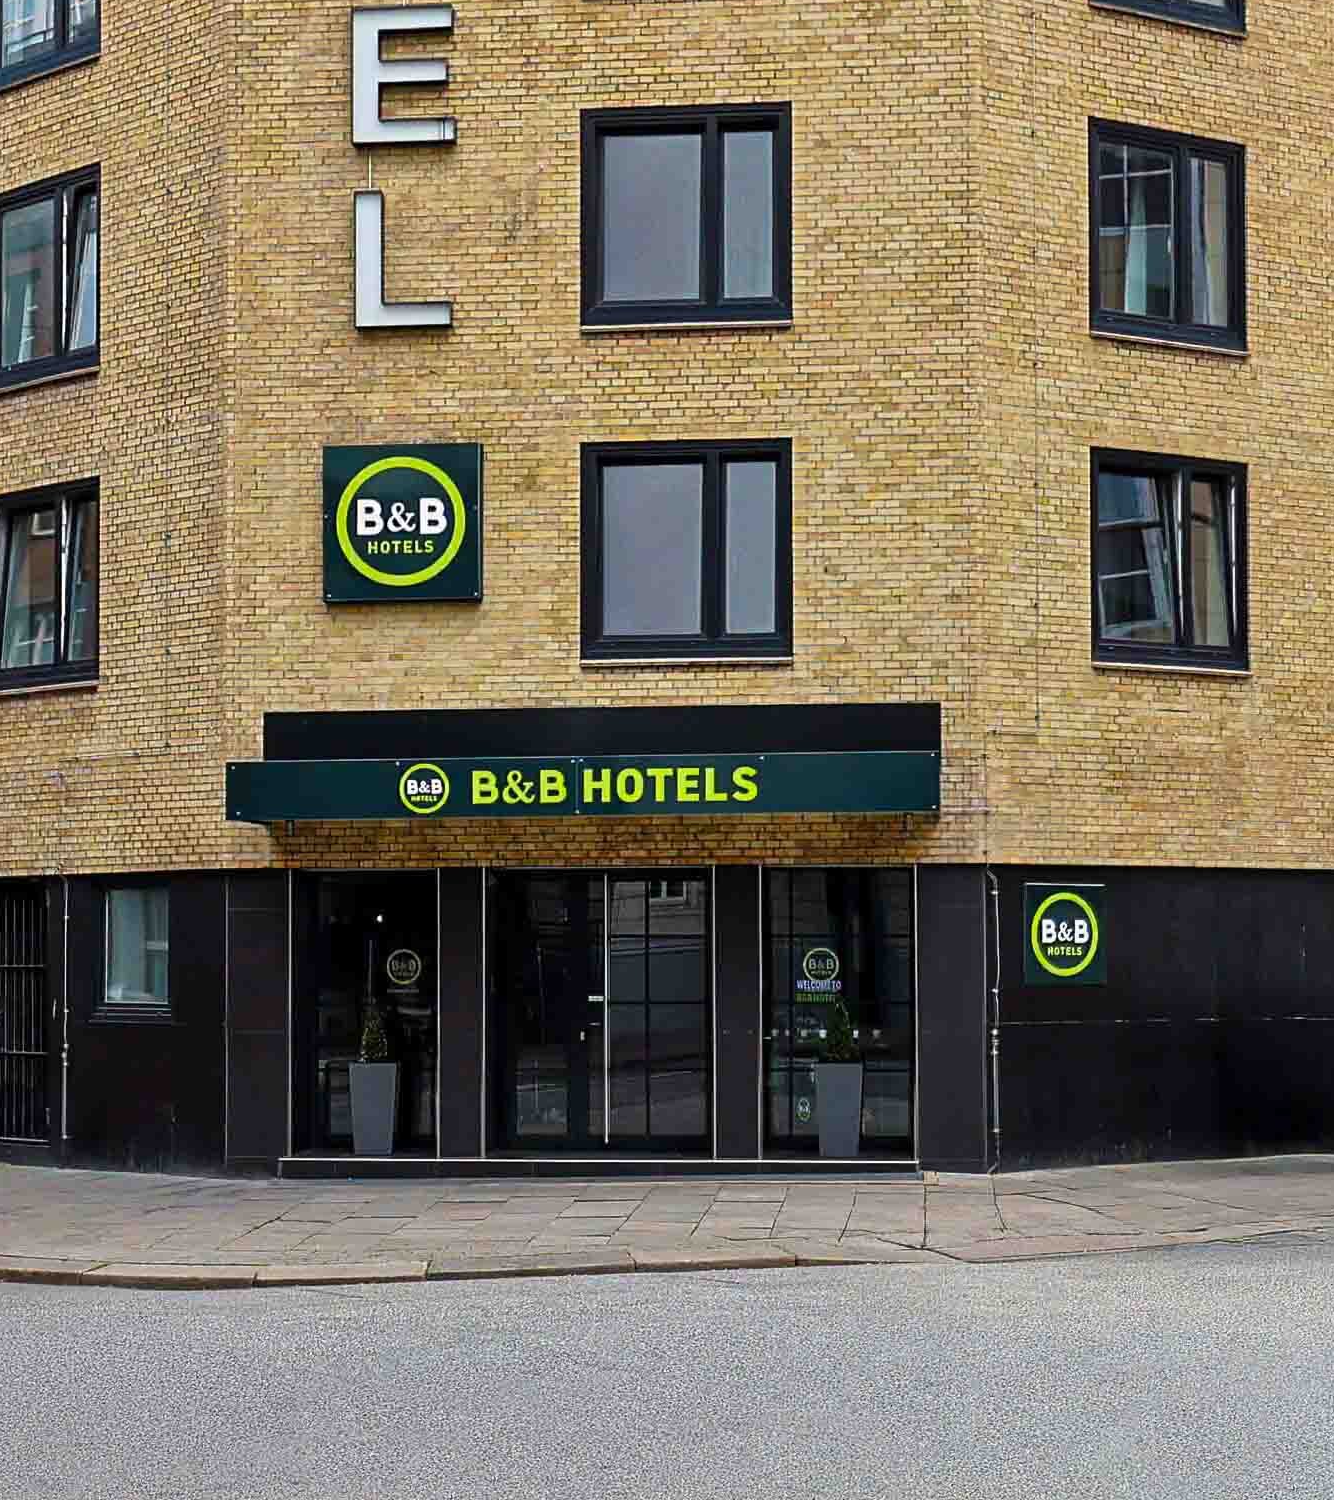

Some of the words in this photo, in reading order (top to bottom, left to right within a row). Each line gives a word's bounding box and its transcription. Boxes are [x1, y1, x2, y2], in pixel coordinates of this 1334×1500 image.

[356, 497, 448, 536] B&B
[367, 540, 435, 555] HOTELS
[406, 779, 443, 795] B&B
[472, 769, 567, 805] B&B
[583, 766, 759, 804] HOTELS
[1041, 918, 1090, 944] B&B
[1047, 946, 1083, 956] HOTELS
